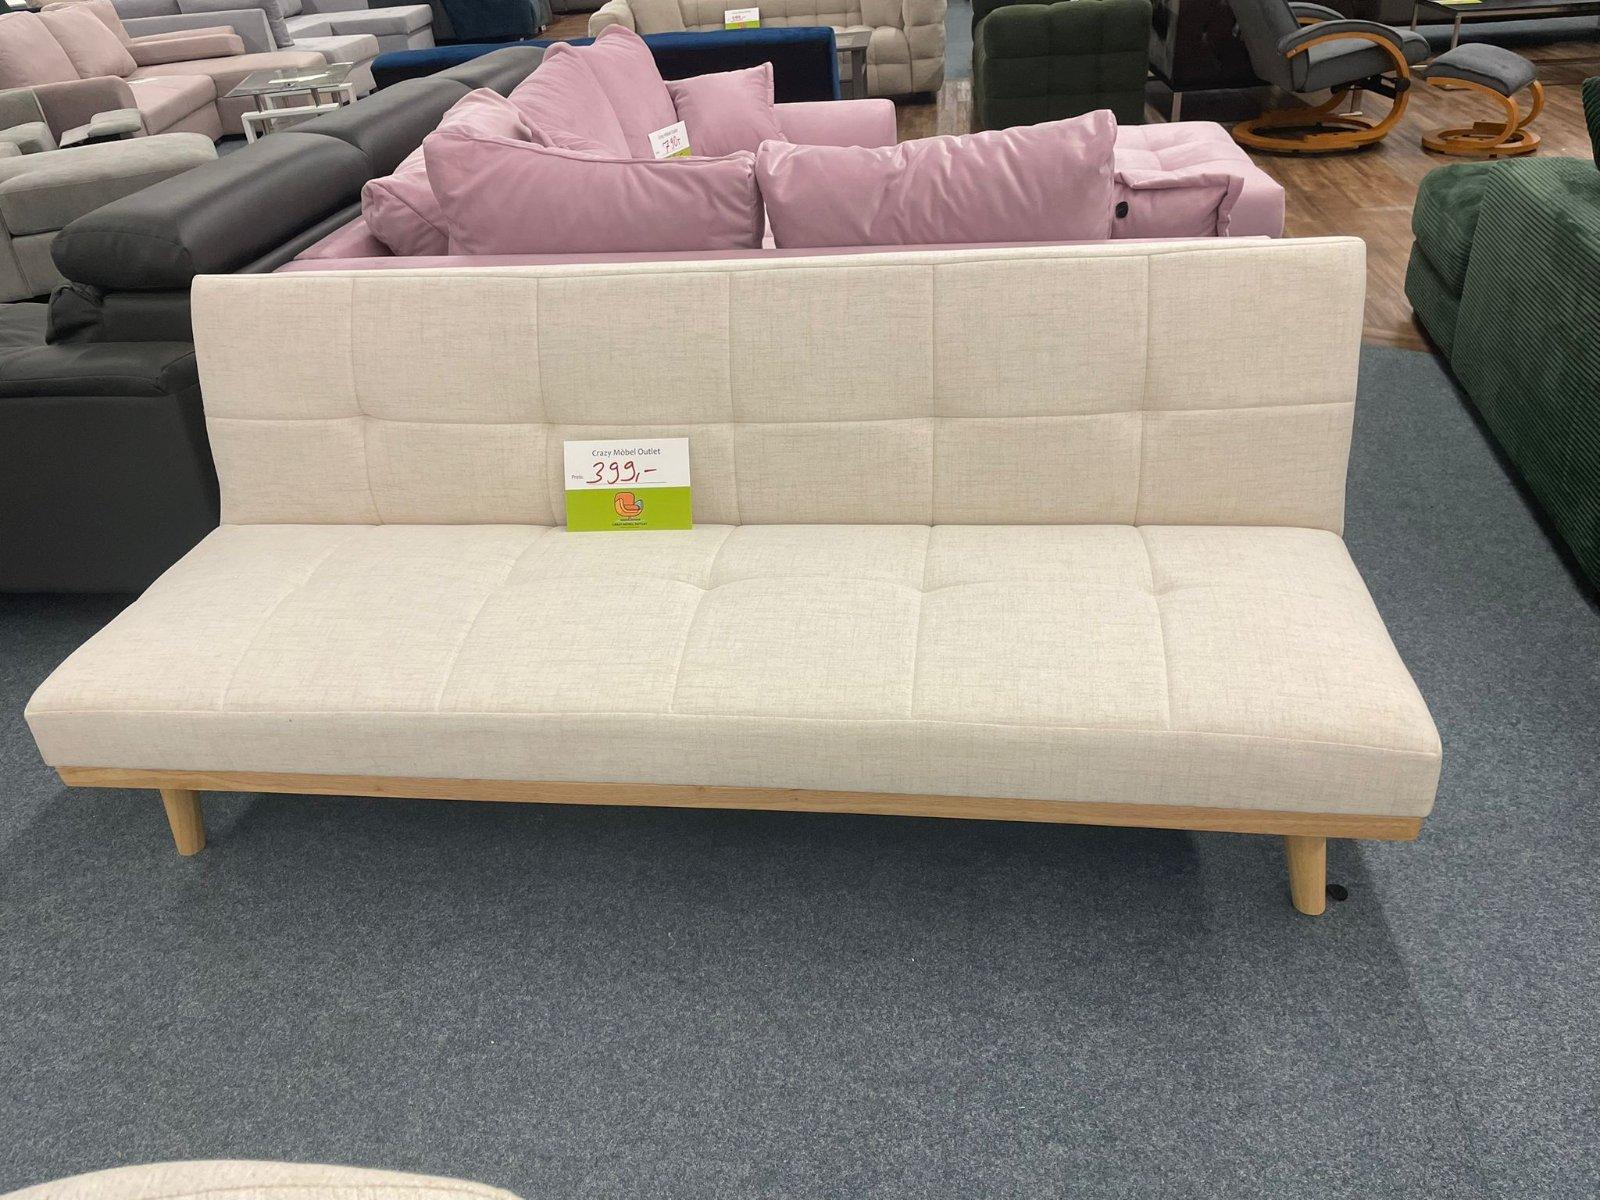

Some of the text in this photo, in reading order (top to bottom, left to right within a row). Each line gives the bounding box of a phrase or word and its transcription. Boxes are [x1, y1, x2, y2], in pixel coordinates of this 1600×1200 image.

[591, 447, 661, 458] Crazy Möbel Outlet
[586, 460, 657, 485] 399,-
